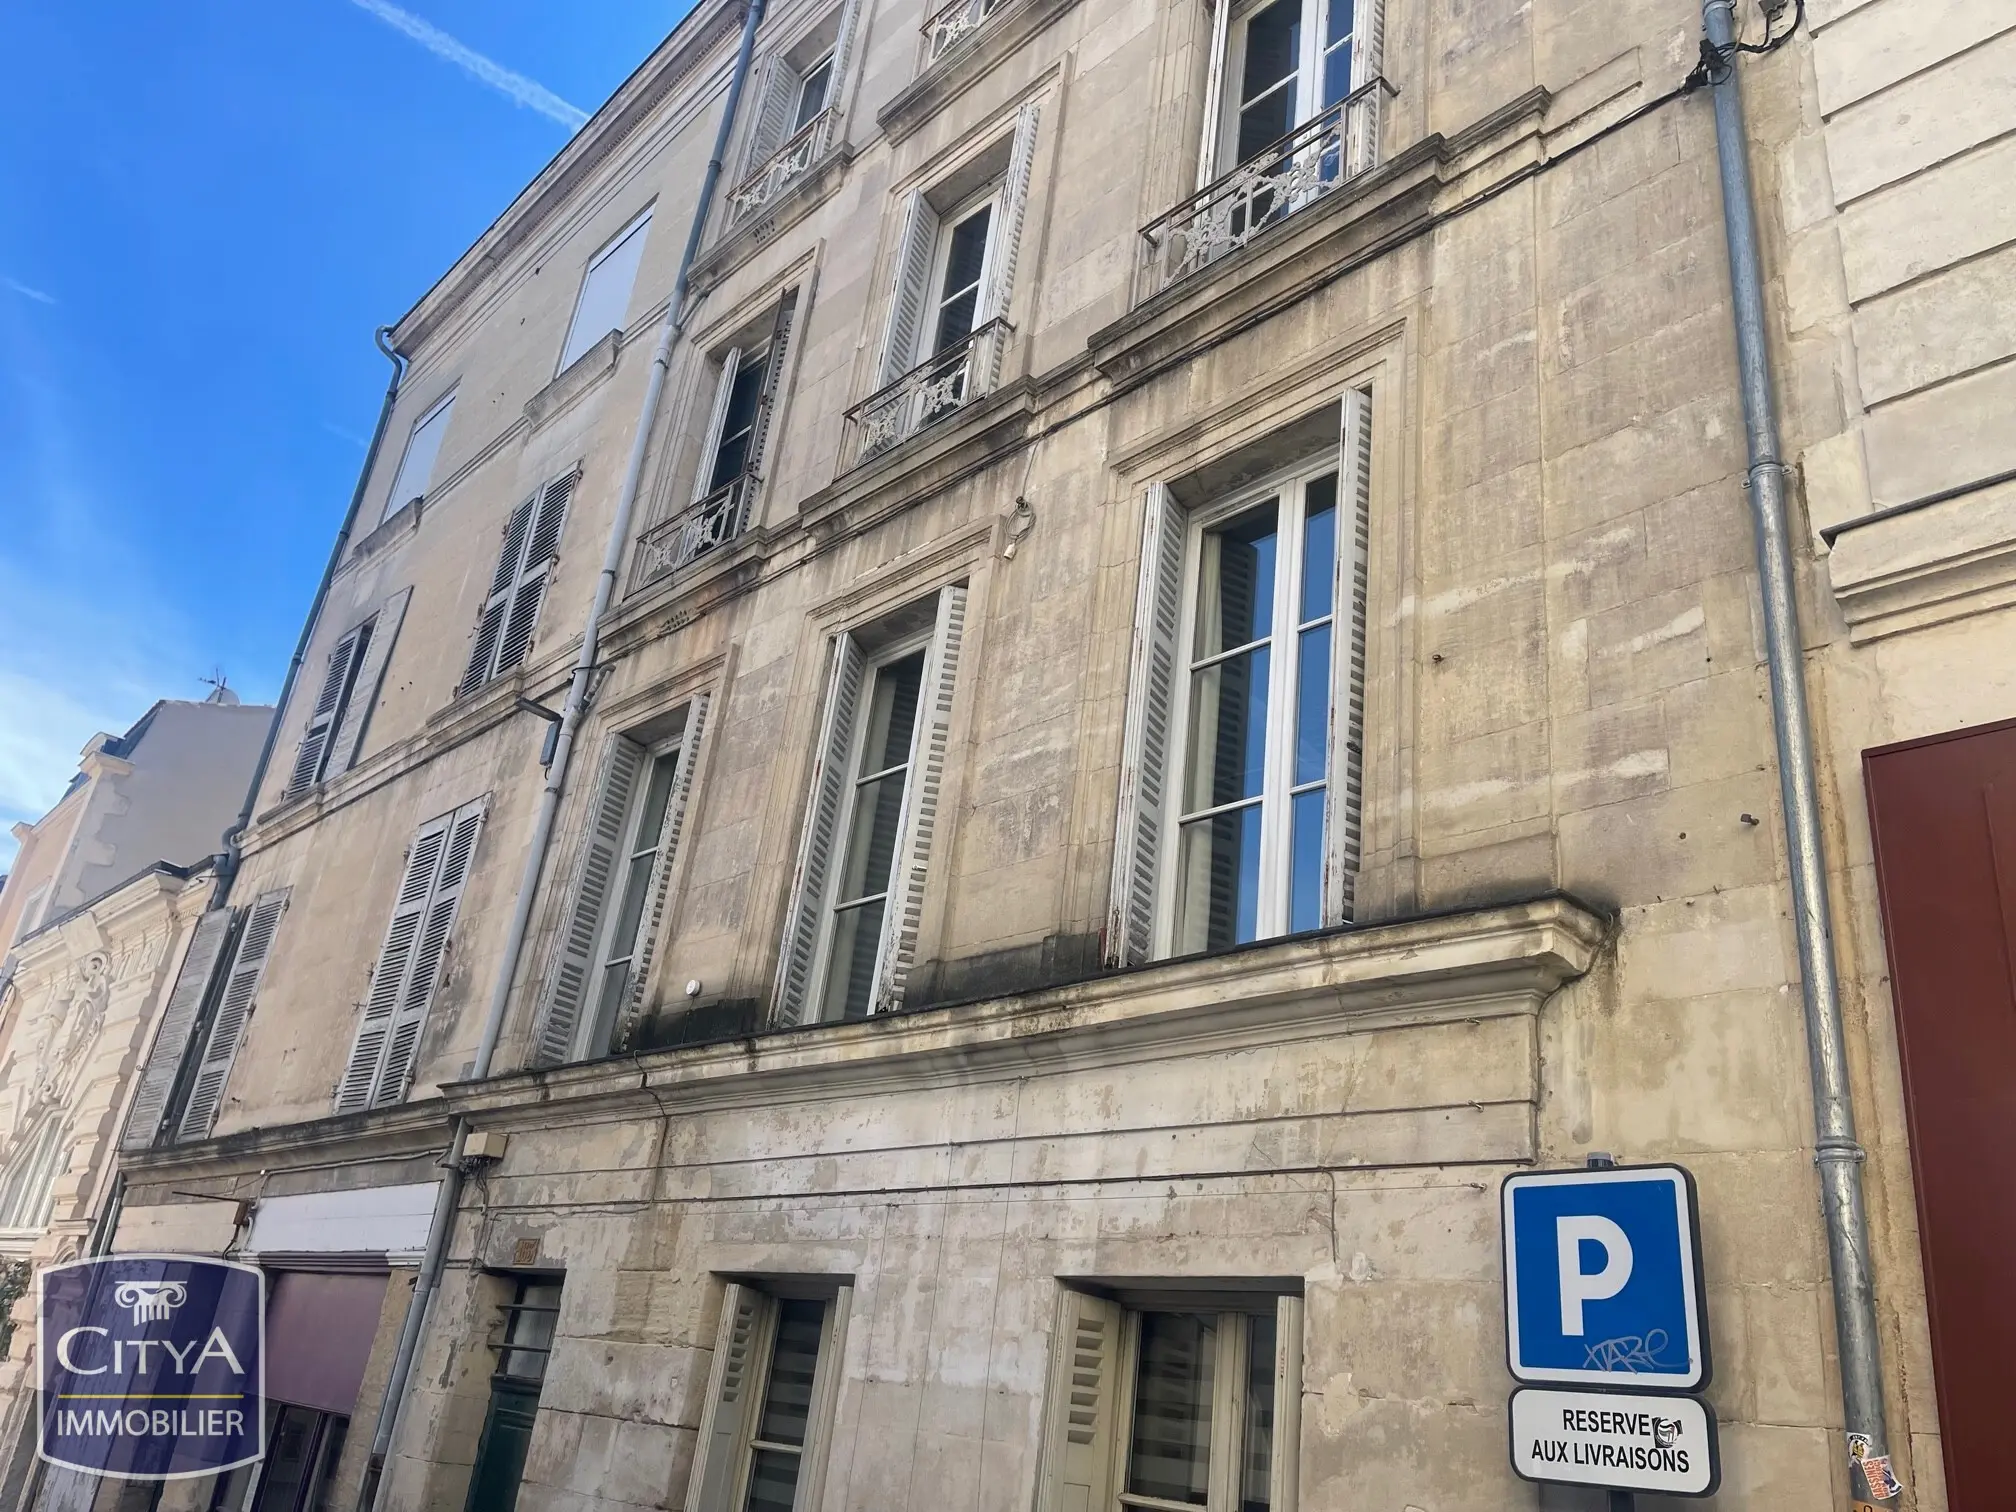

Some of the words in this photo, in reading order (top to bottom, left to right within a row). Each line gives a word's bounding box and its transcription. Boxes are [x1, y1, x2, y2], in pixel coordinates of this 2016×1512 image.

[1556, 1215, 1634, 1336] P
[1531, 1439, 1569, 1463] AUX
[1574, 1442, 1690, 1473] LIVRAISONS
